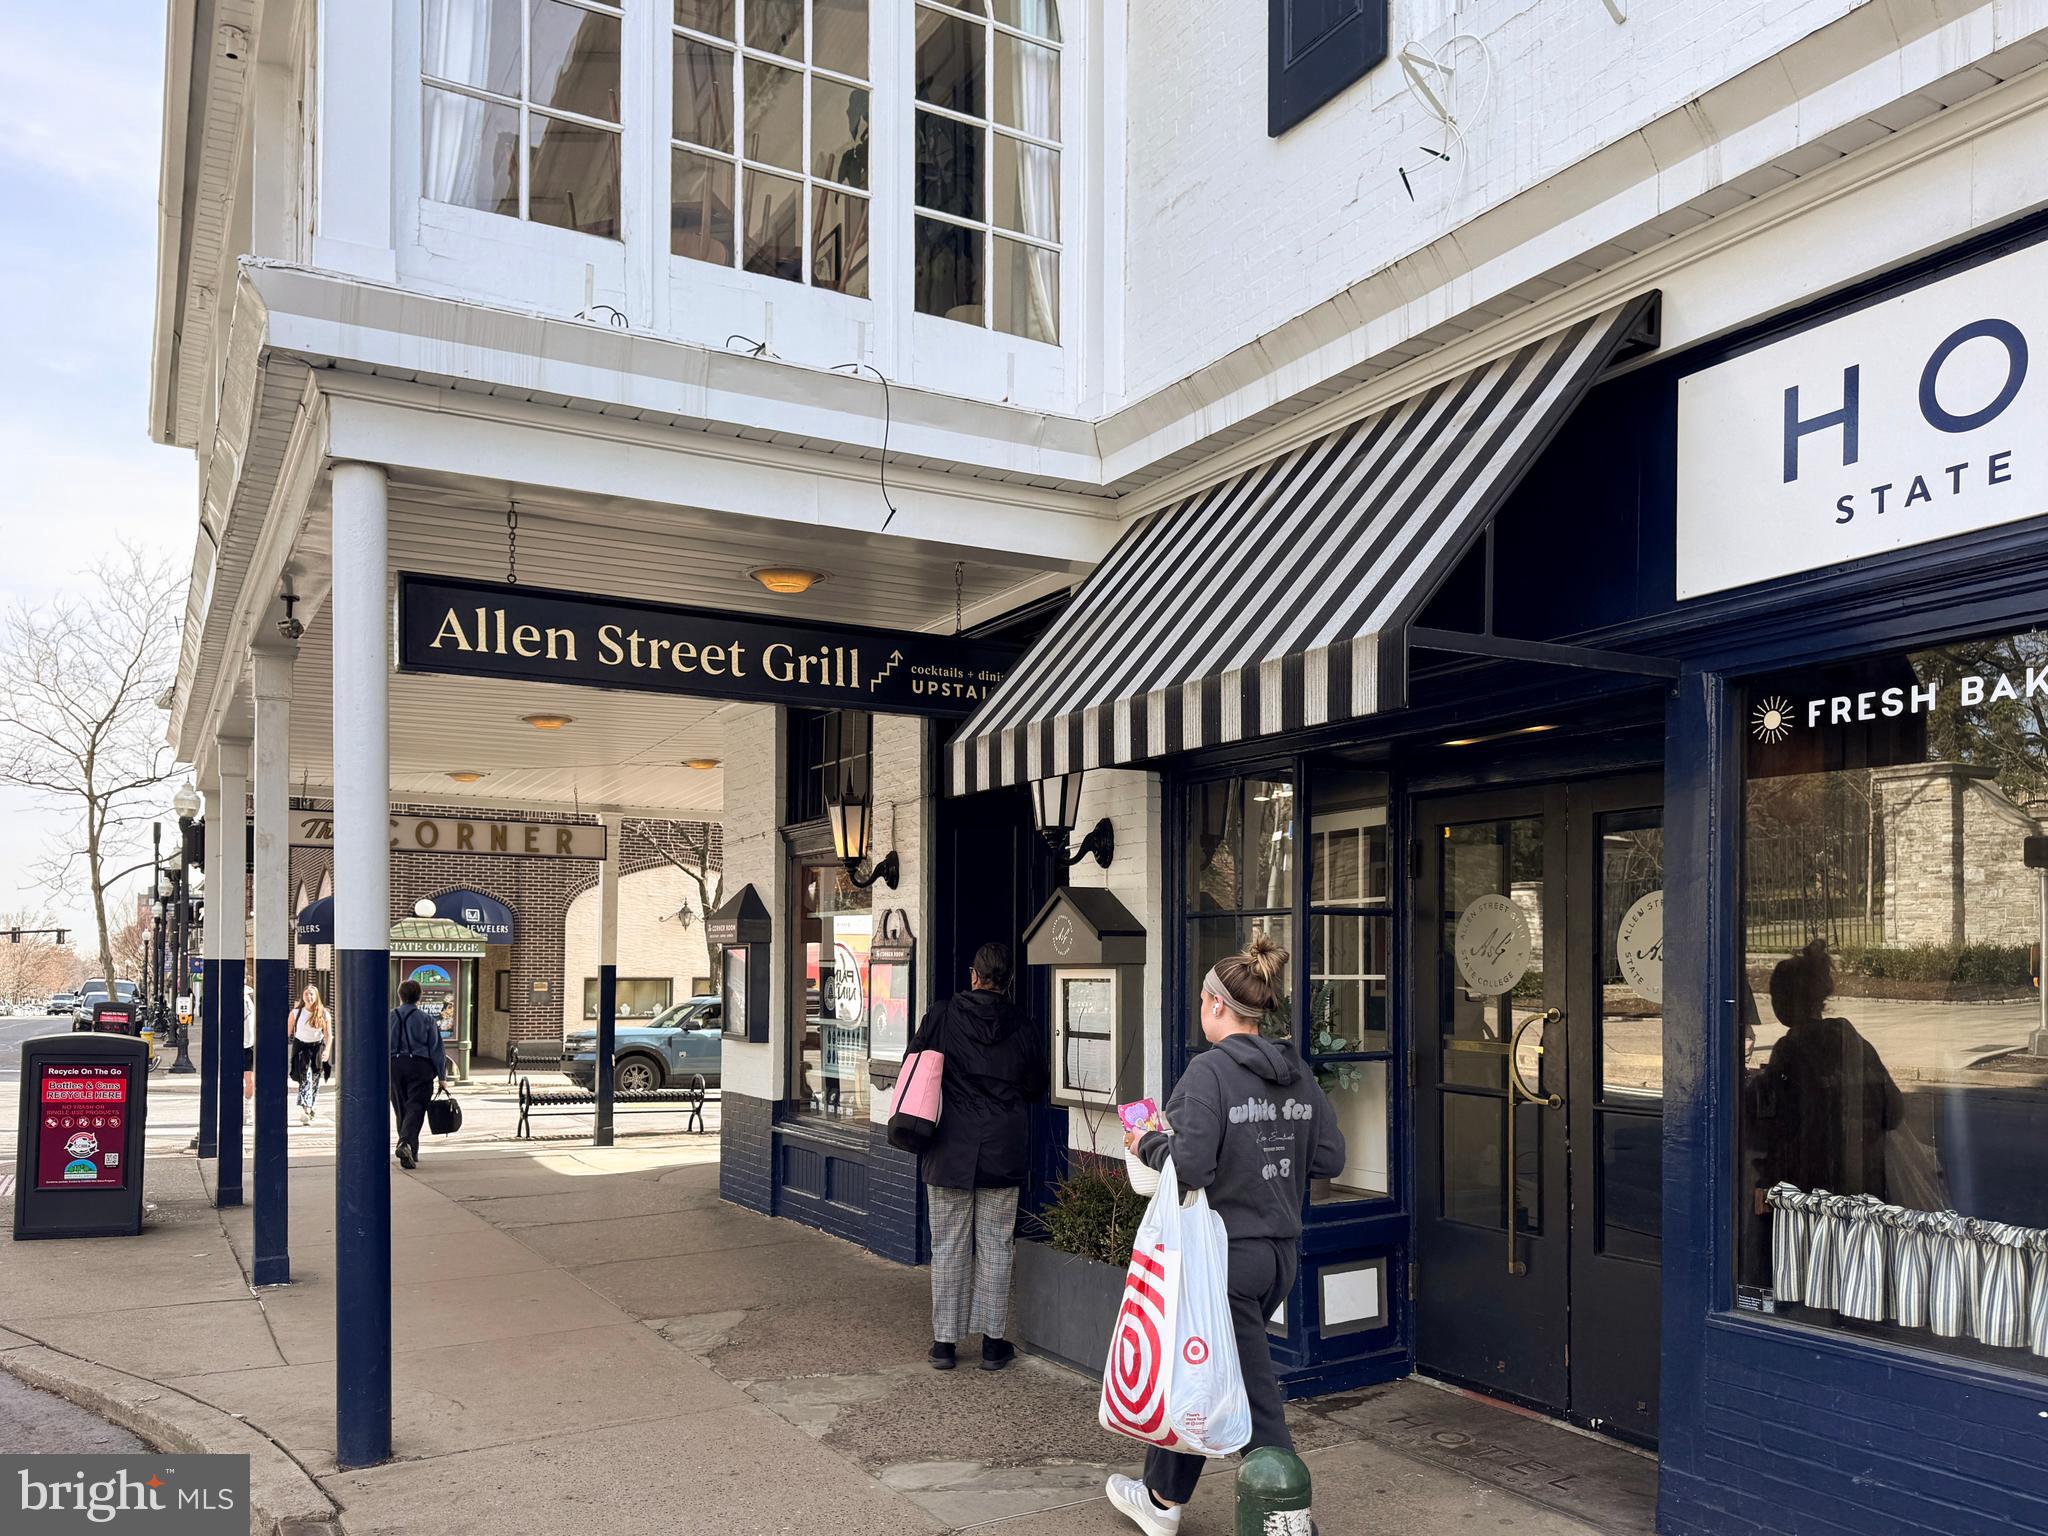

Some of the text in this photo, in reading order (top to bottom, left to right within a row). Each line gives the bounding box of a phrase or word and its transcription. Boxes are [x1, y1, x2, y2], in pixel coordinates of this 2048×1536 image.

[1783, 318, 2029, 484] HO
[1835, 450, 2012, 524] STATE
[429, 607, 860, 689] Allen Street Grill
[911, 665, 964, 678] cocktails
[978, 670, 1004, 682] dini
[912, 679, 994, 700] UPSTAI
[1808, 667, 2048, 728] FRESH BAK
[301, 818, 334, 840] Th
[1479, 902, 1510, 913] STREET
[298, 924, 320, 934] ELERS
[1623, 907, 1645, 942] ALLEN
[425, 943, 479, 952] COLLEGE
[1477, 970, 1514, 987] COLLEGE
[1625, 951, 1645, 985] STATE
[48, 1067, 79, 1076] Recycle
[47, 1091, 122, 1100] RECYCLE HERE
[48, 1081, 121, 1090] Bottles & Cans
[1229, 1096, 1312, 1124] white fox
